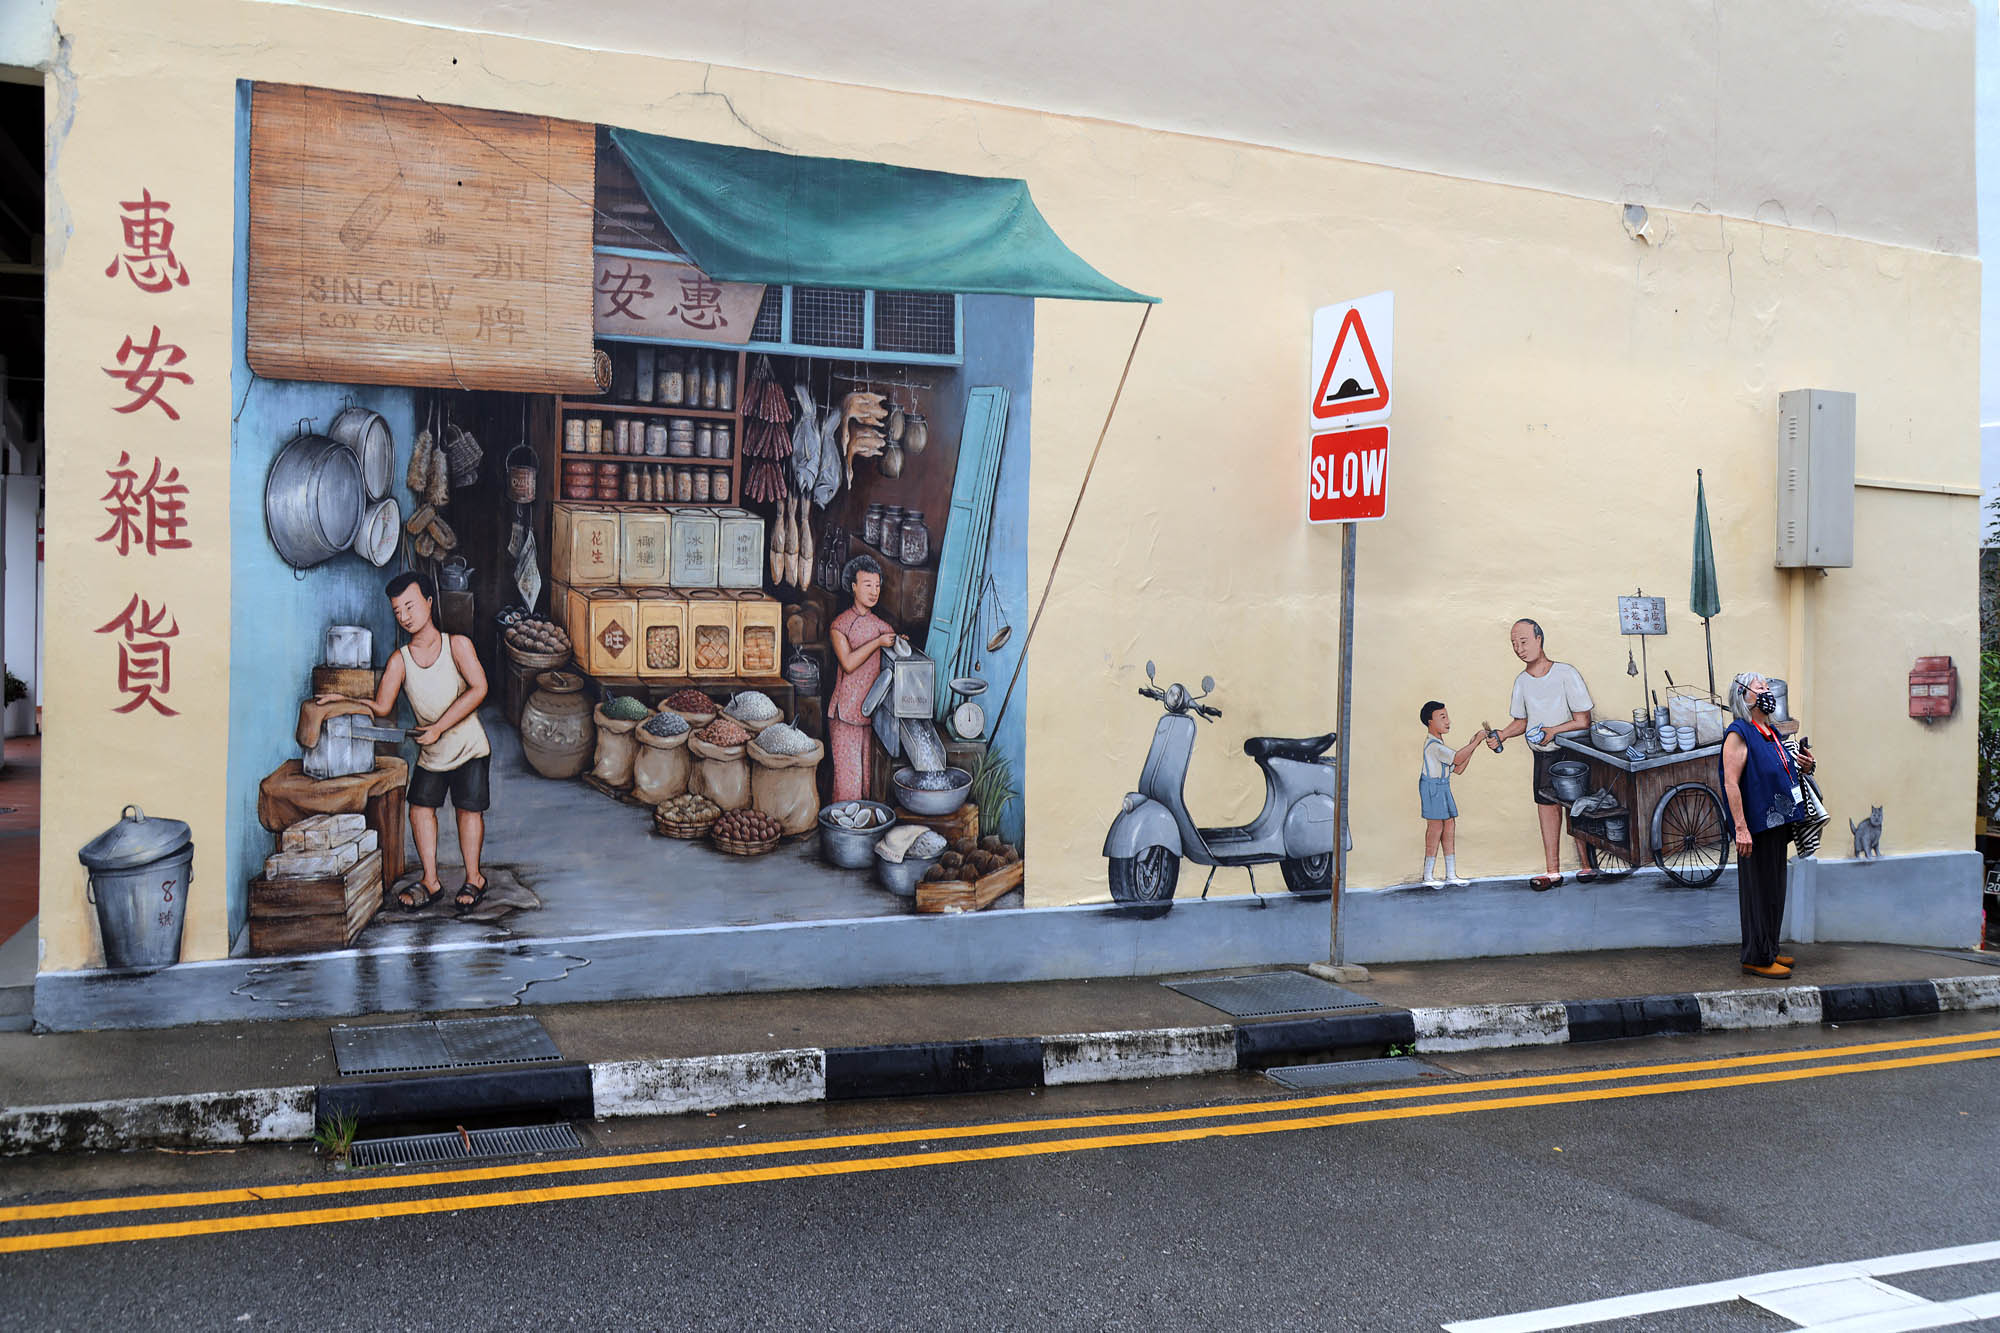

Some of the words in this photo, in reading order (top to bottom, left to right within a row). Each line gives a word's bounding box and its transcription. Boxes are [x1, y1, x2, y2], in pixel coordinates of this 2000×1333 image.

[308, 274, 363, 305] SIN
[377, 279, 454, 311] CHEW
[319, 311, 359, 329] SOY
[374, 313, 444, 336] SAUCE
[94, 187, 194, 716] 惠安雜貨
[1311, 448, 1386, 500] SLOW
[592, 530, 604, 564] 花生
[686, 536, 703, 565] 冰糖
[605, 630, 624, 649] 旺
